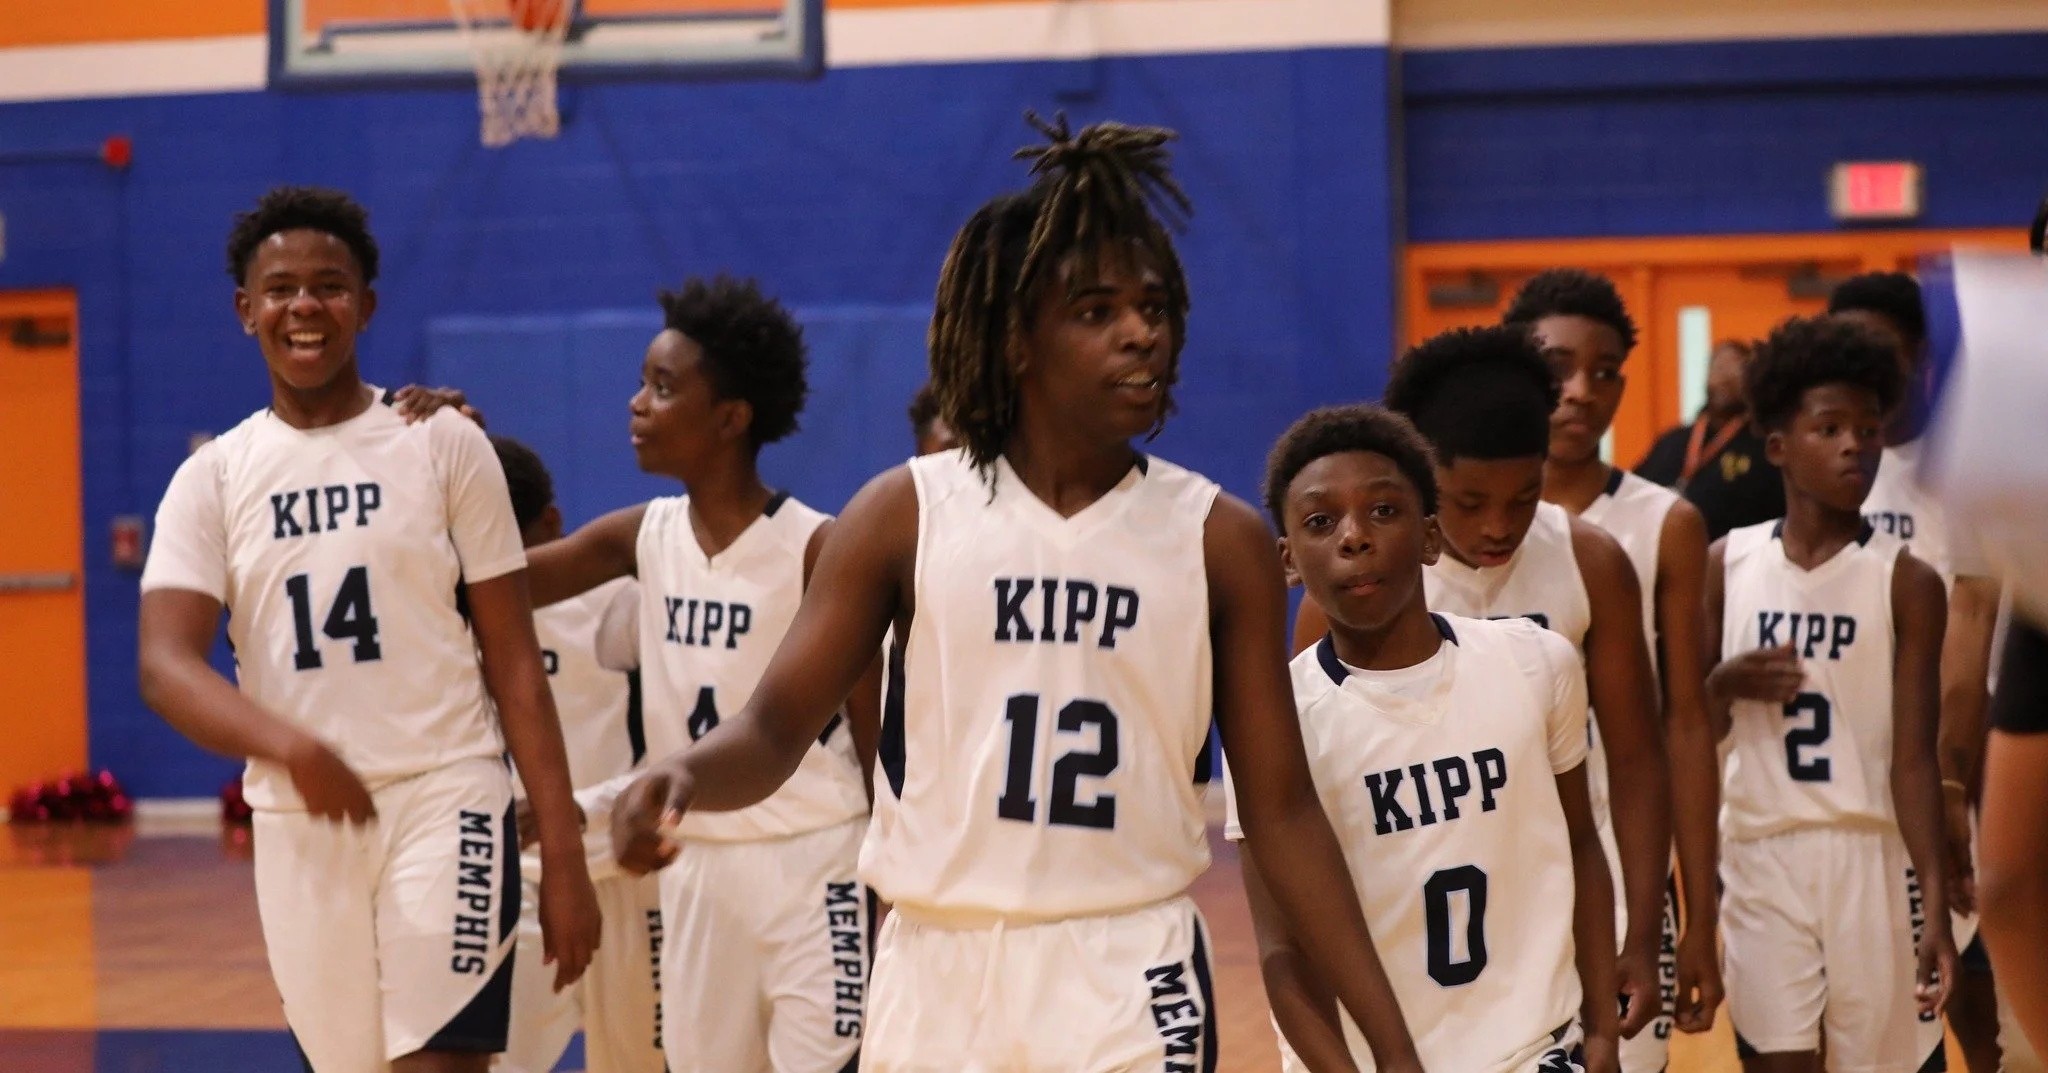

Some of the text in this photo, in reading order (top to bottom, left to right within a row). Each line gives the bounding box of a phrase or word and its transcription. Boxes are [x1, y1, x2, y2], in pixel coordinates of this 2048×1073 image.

[270, 482, 381, 539] KIPP
[285, 565, 382, 672] 14
[664, 596, 752, 649] KIPP
[993, 577, 1140, 650] KIPP
[1758, 611, 1856, 661] KIPP
[997, 692, 1120, 831] 12
[1783, 692, 1831, 782] 2
[1363, 747, 1508, 836] KIPP
[451, 810, 494, 977] MEMPHIS
[1423, 864, 1488, 988] 0
[825, 880, 864, 1040] MEMPHIS
